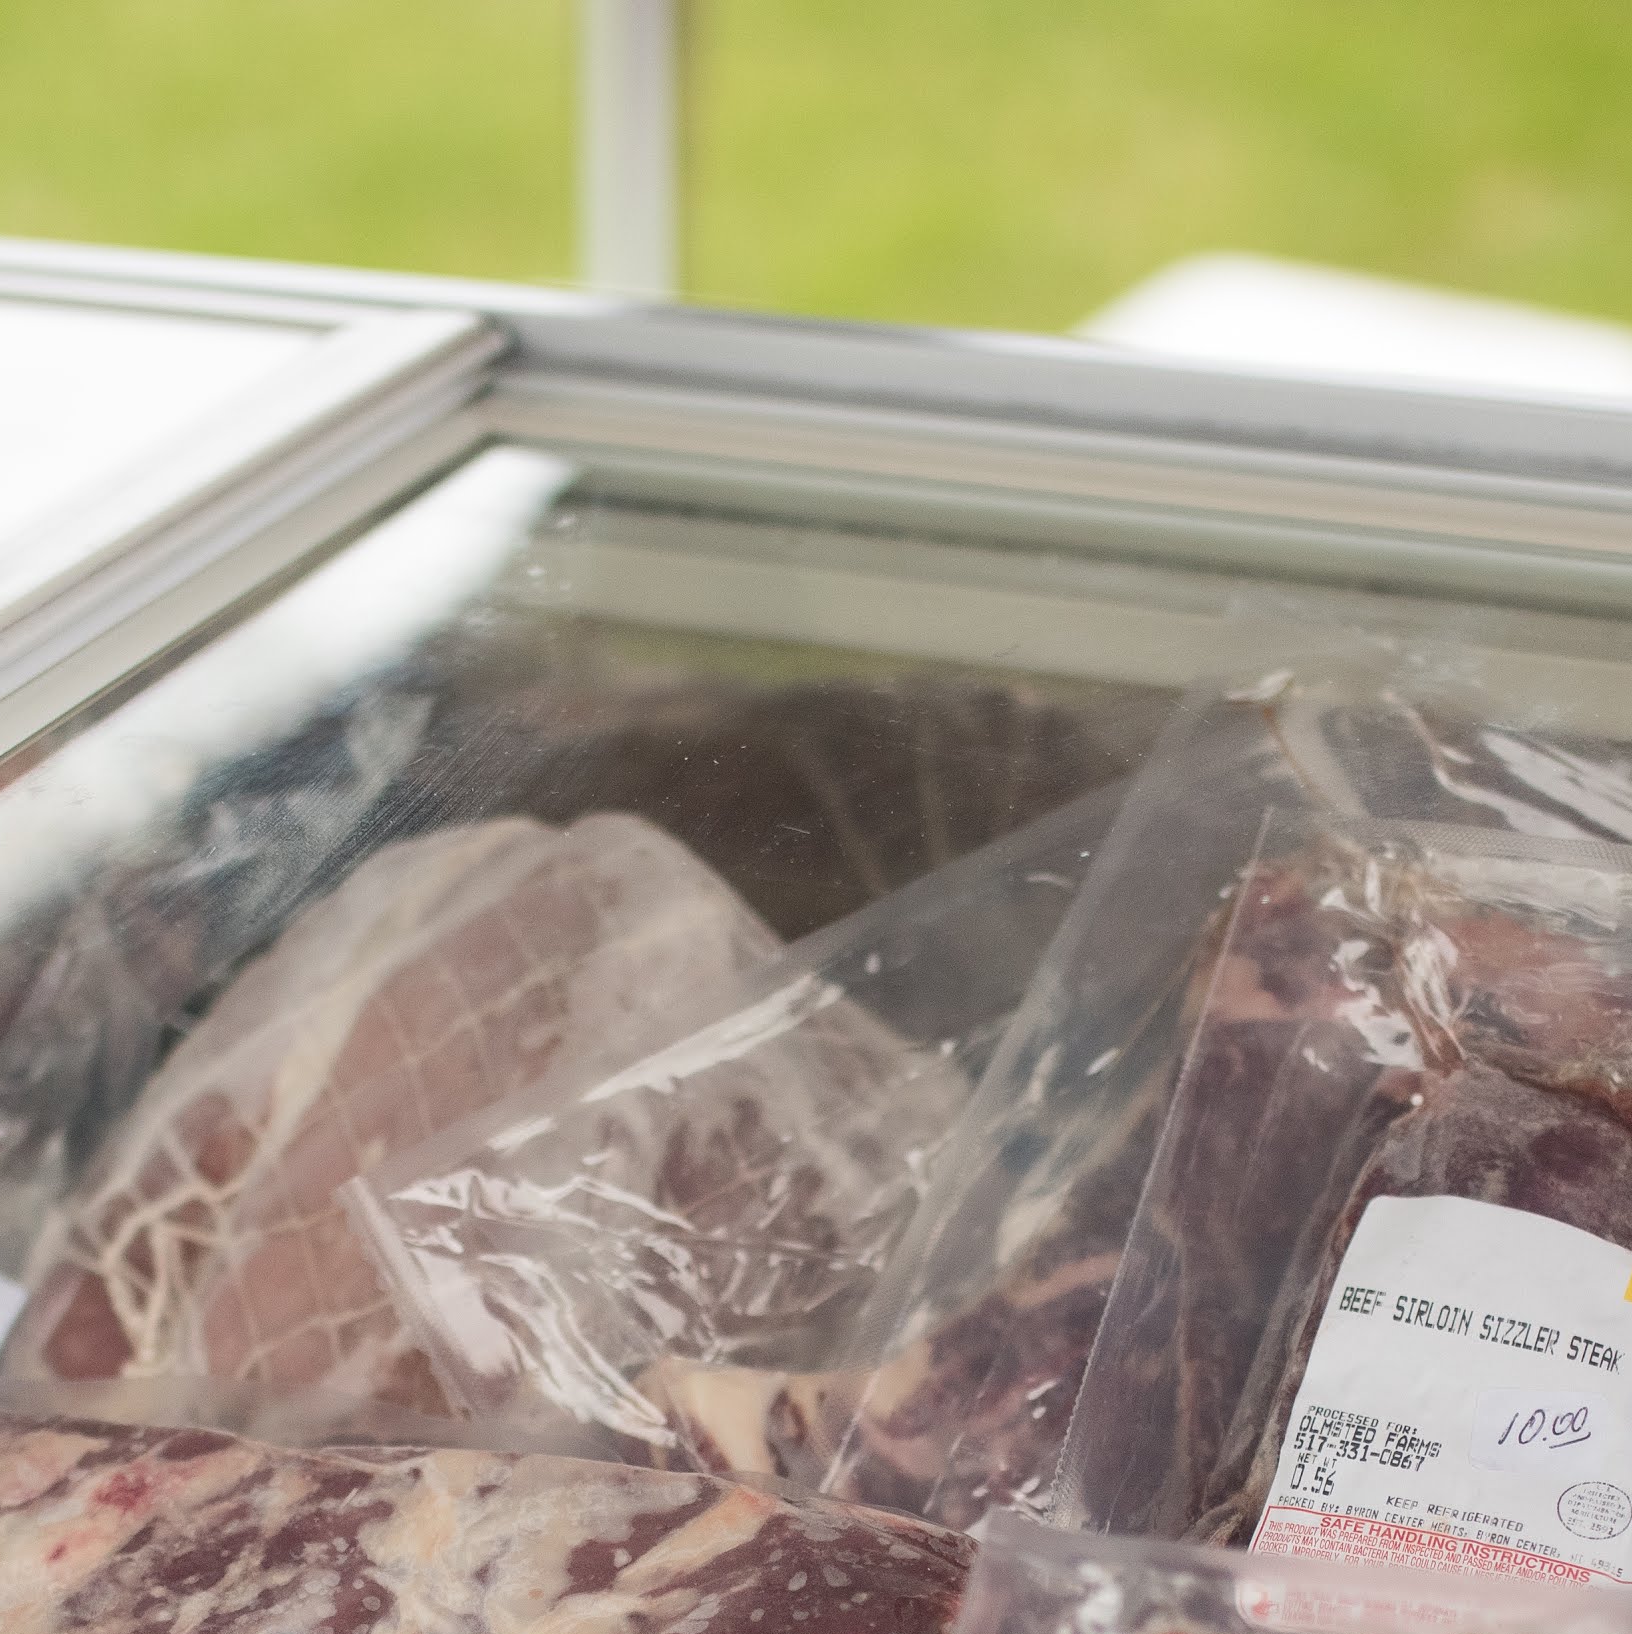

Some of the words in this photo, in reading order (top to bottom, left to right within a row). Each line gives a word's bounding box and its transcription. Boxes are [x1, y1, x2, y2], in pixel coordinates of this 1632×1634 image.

[1339, 1286, 1386, 1316] BEEF
[1393, 1295, 1473, 1336] SIRLOIN
[1479, 1314, 1560, 1355] SIZZLER
[1567, 1335, 1625, 1375] STEAK
[1299, 1415, 1377, 1444] OLMSTED
[1384, 1432, 1442, 1458] FARMS
[1308, 1405, 1379, 1428] PROCESSED
[1386, 1421, 1418, 1435] FOR:
[1498, 1406, 1591, 1449] 10.00
[1293, 1432, 1426, 1472] 517-331-0867
[1297, 1452, 1318, 1465] NET
[1290, 1463, 1336, 1496] 0.56
[1277, 1495, 1315, 1510] PACKED
[1320, 1502, 1339, 1514] BY:
[1345, 1505, 1379, 1520] BYRON
[1384, 1512, 1425, 1528] CENTER
[1386, 1495, 1419, 1510] KEEP
[1426, 1503, 1524, 1532] REFRIGERATED
[1258, 1541, 1288, 1554] COOKED
[1262, 1531, 1301, 1545] PRODUCTS
[1301, 1536, 1319, 1548] MAY
[1319, 1540, 1352, 1553] CONTAIN
[1352, 1546, 1390, 1561] BACTERIA
[1390, 1551, 1410, 1564] THAT
[1410, 1555, 1437, 1569] COULD
[1267, 1520, 1283, 1531] THIS
[1284, 1522, 1319, 1536] PRODUCT
[1320, 1528, 1337, 1538] WAS
[1338, 1531, 1378, 1547] PREPARED
[1379, 1538, 1401, 1551] FROM
[1402, 1542, 1444, 1560] INSPECTED
[1444, 1550, 1462, 1564] AND
[1462, 1554, 1494, 1572] PASSED
[1494, 1561, 1516, 1574] MEAT
[1516, 1565, 1546, 1582] AND/OR
[1320, 1516, 1366, 1533] SAFE
[1368, 1523, 1458, 1551] HANDLING
[1461, 1542, 1591, 1583] INSTRUCTIONS
